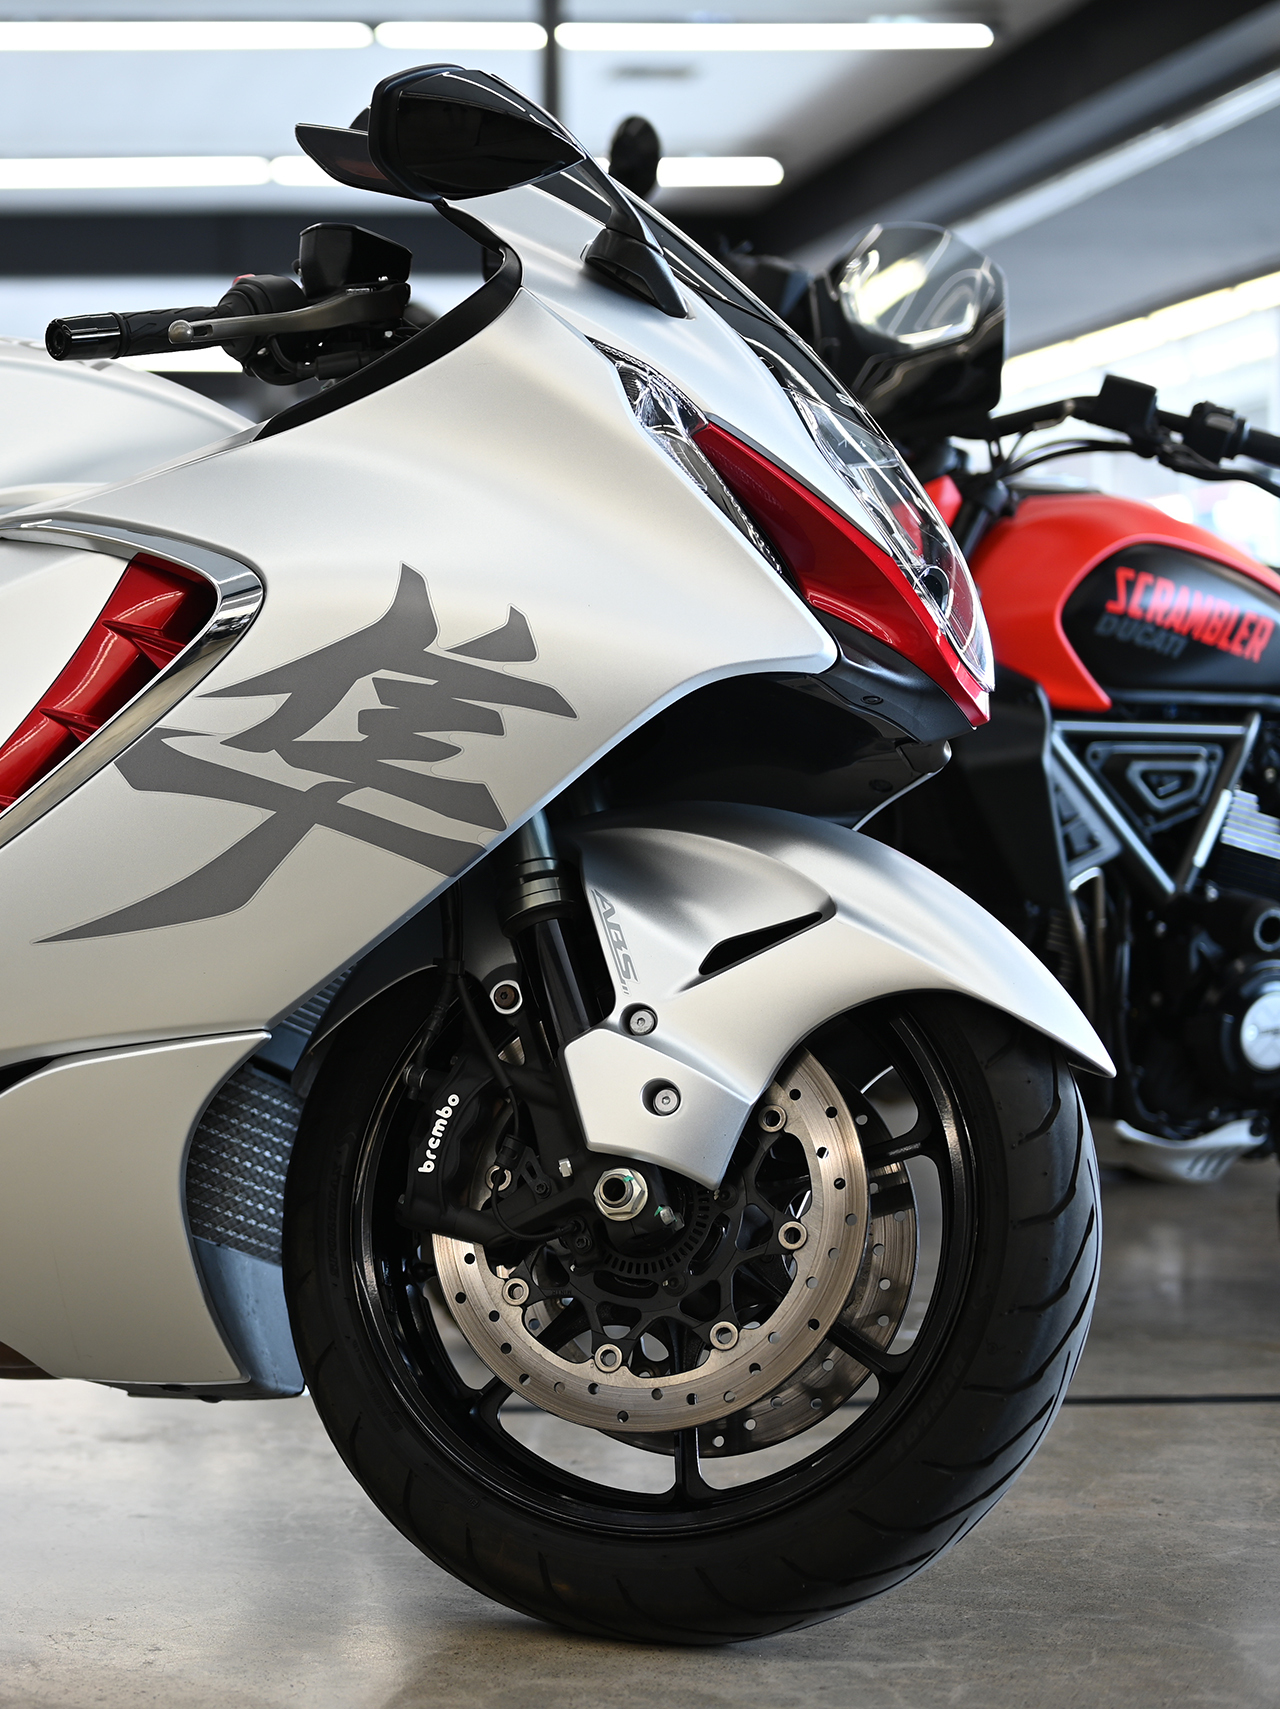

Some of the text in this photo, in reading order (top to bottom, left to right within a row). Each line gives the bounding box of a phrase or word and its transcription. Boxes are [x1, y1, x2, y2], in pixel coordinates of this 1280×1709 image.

[1094, 612, 1188, 659] DUCATI
[1105, 566, 1274, 663] SCRAMBLER
[593, 889, 638, 982] ABS
[418, 1094, 459, 1173] brembo
[891, 1353, 967, 1462] DUNLOP
